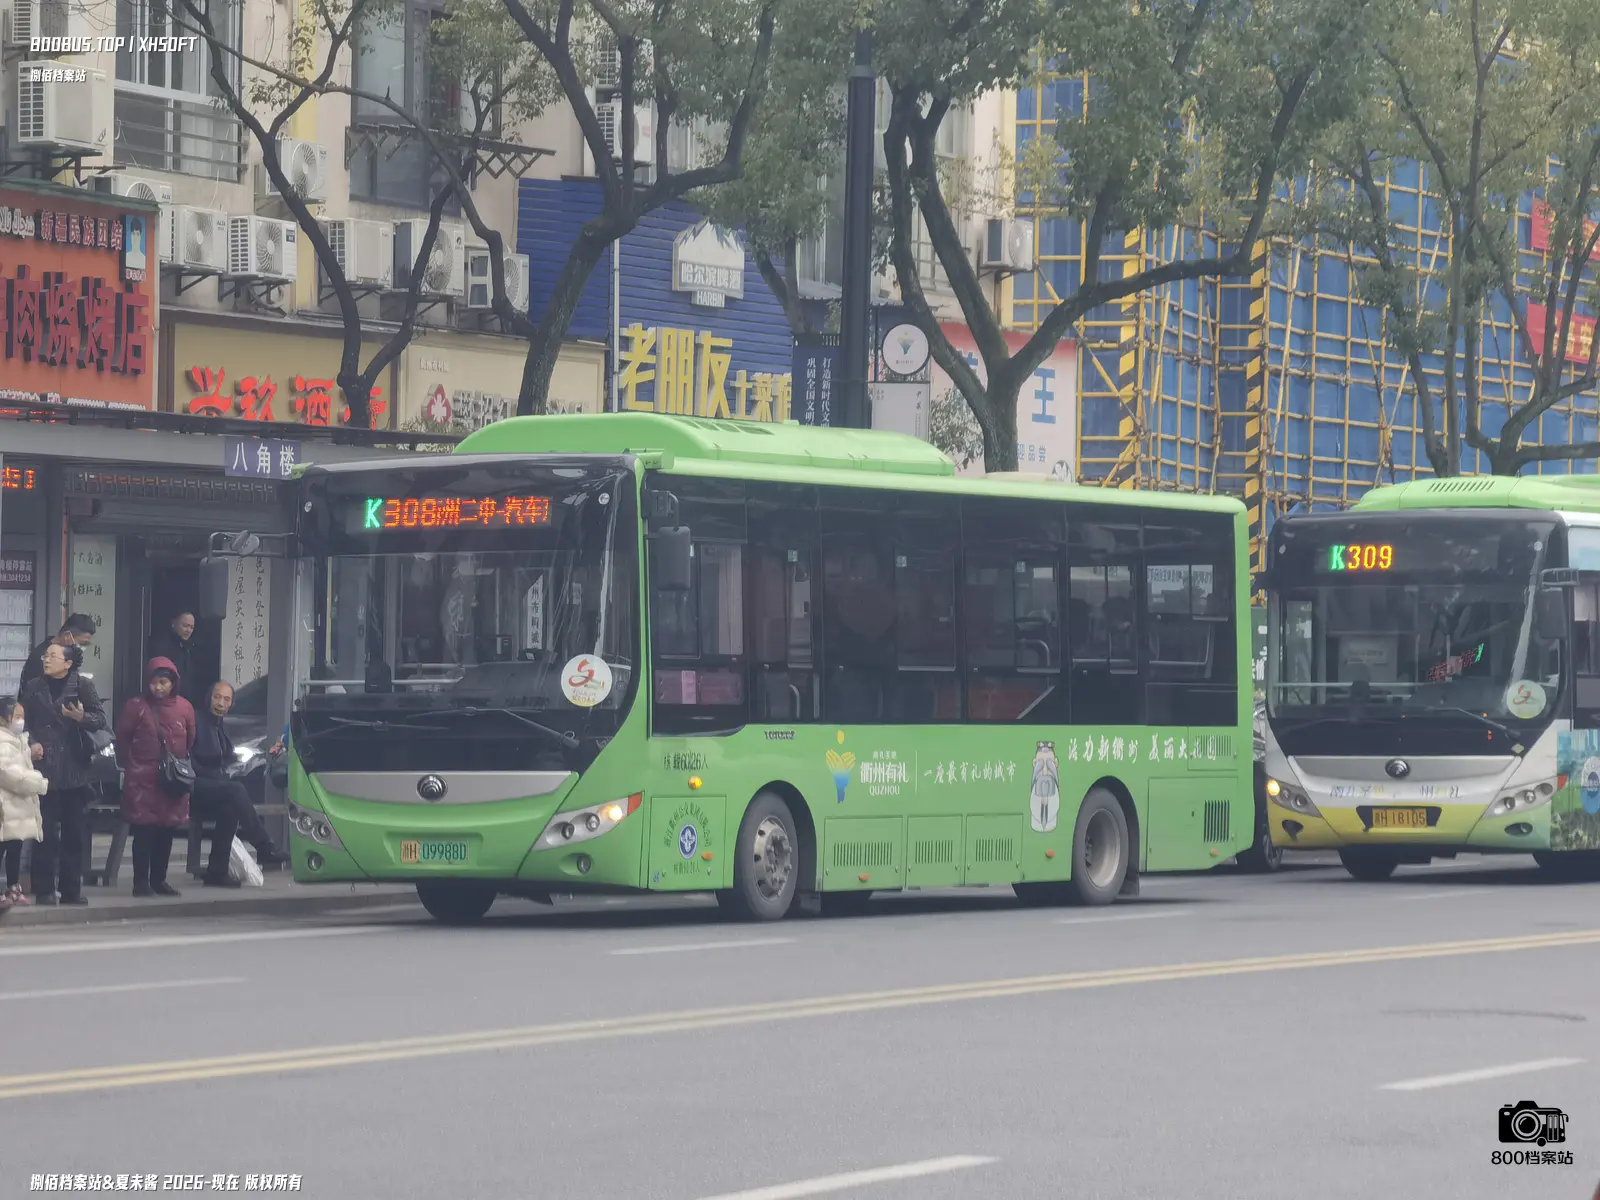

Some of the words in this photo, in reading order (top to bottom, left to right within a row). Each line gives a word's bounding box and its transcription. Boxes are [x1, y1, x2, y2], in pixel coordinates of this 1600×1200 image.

[41, 209, 123, 250] 新疆民族团结
[681, 262, 741, 290] 哈尔滨啤酒
[696, 290, 725, 308] HARBIN
[619, 323, 733, 420] 老朋友
[232, 441, 295, 476] 八角楼
[1330, 544, 1393, 570] K309
[860, 761, 909, 784] 衢州有礼
[869, 785, 900, 796] QUZHOU
